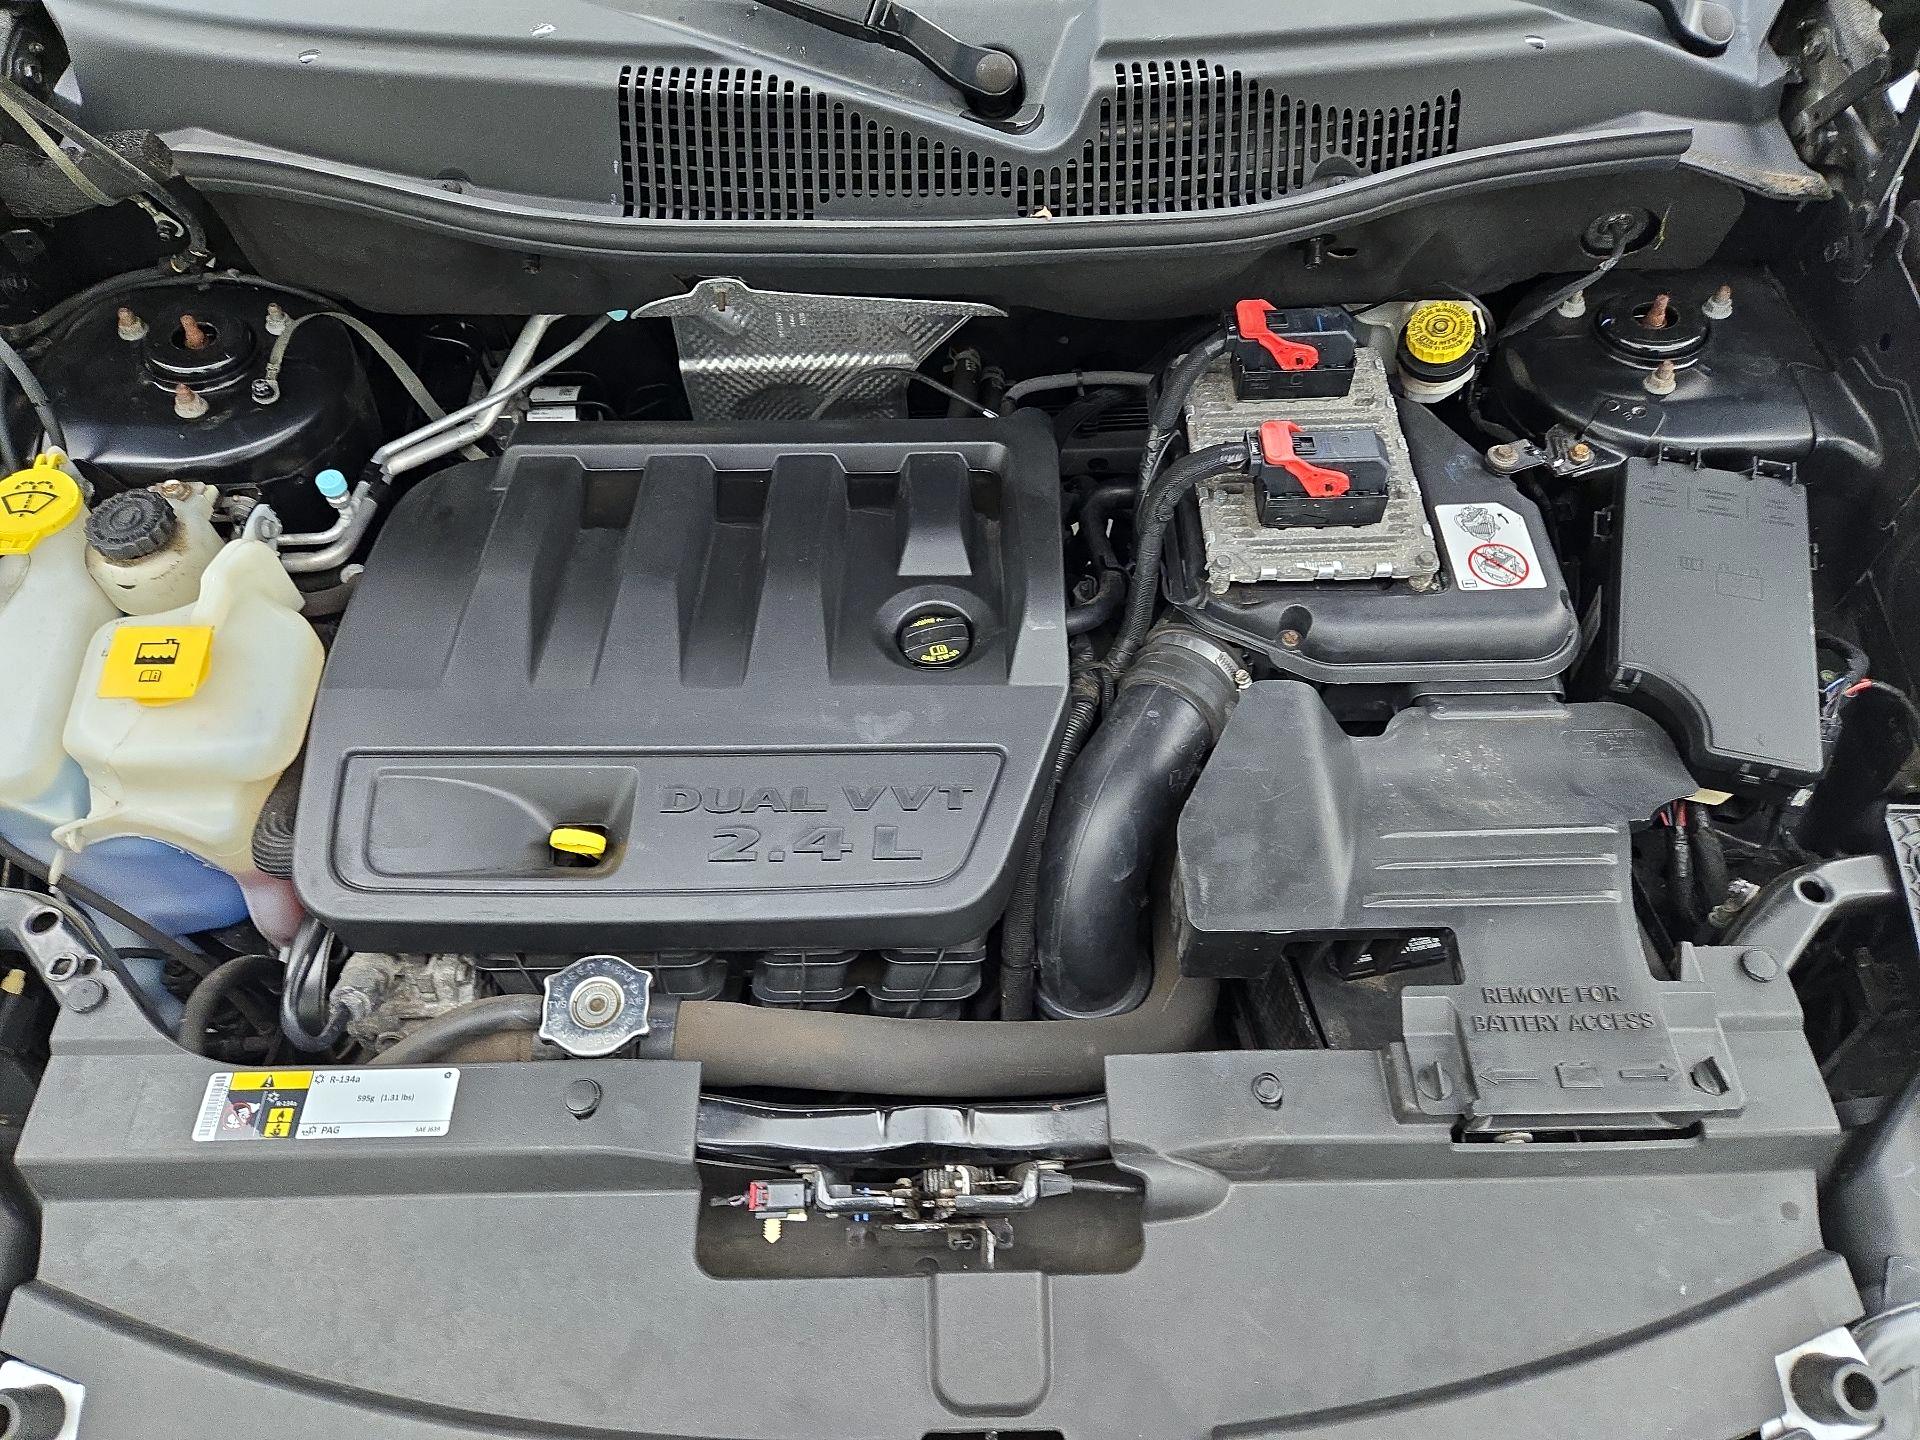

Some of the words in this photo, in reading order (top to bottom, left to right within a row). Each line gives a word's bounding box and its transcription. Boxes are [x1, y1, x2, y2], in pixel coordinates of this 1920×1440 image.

[659, 787, 828, 814] DUAL
[842, 786, 974, 812] VVT
[1481, 986, 1572, 1004] REMOVE
[1575, 985, 1623, 1002] FOR
[548, 1001, 567, 1009] TVS
[1472, 1013, 1560, 1033] BATTERY
[1568, 1011, 1655, 1032] ACCESS
[329, 1075, 361, 1083] R-134a
[356, 1095, 375, 1103] 595g
[380, 1094, 399, 1103] (1.31
[400, 1093, 415, 1102] lbs)
[321, 1126, 341, 1135] PAG
